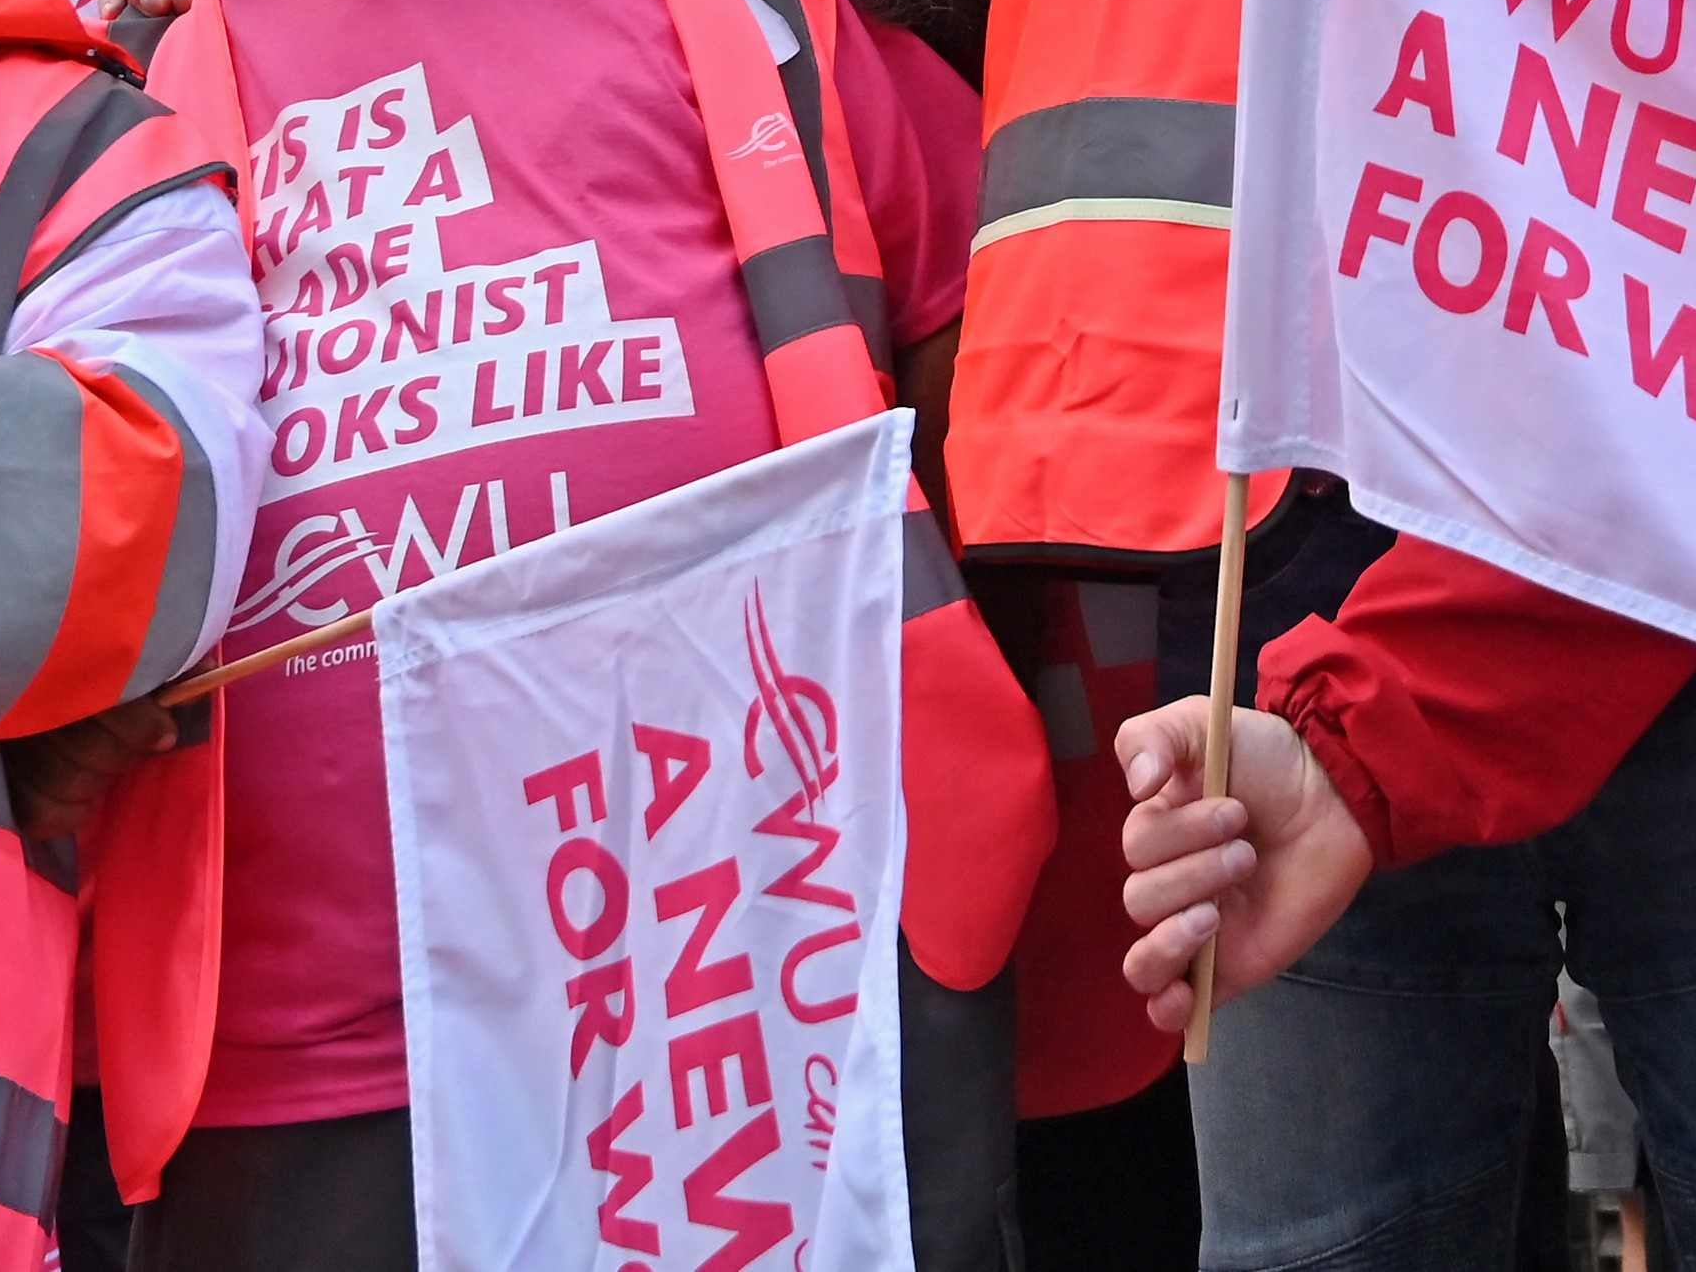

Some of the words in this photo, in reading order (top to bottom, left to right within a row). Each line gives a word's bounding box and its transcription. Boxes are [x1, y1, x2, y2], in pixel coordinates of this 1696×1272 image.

[336, 87, 408, 153] IS
[1372, 9, 1456, 138] A
[251, 165, 385, 285] HAT
[402, 147, 463, 207] A
[1337, 160, 1591, 358] FOR
[470, 336, 662, 429] LIKE
[631, 720, 712, 842] A
[743, 575, 863, 1025] CWU
[522, 748, 636, 1081] FOR
